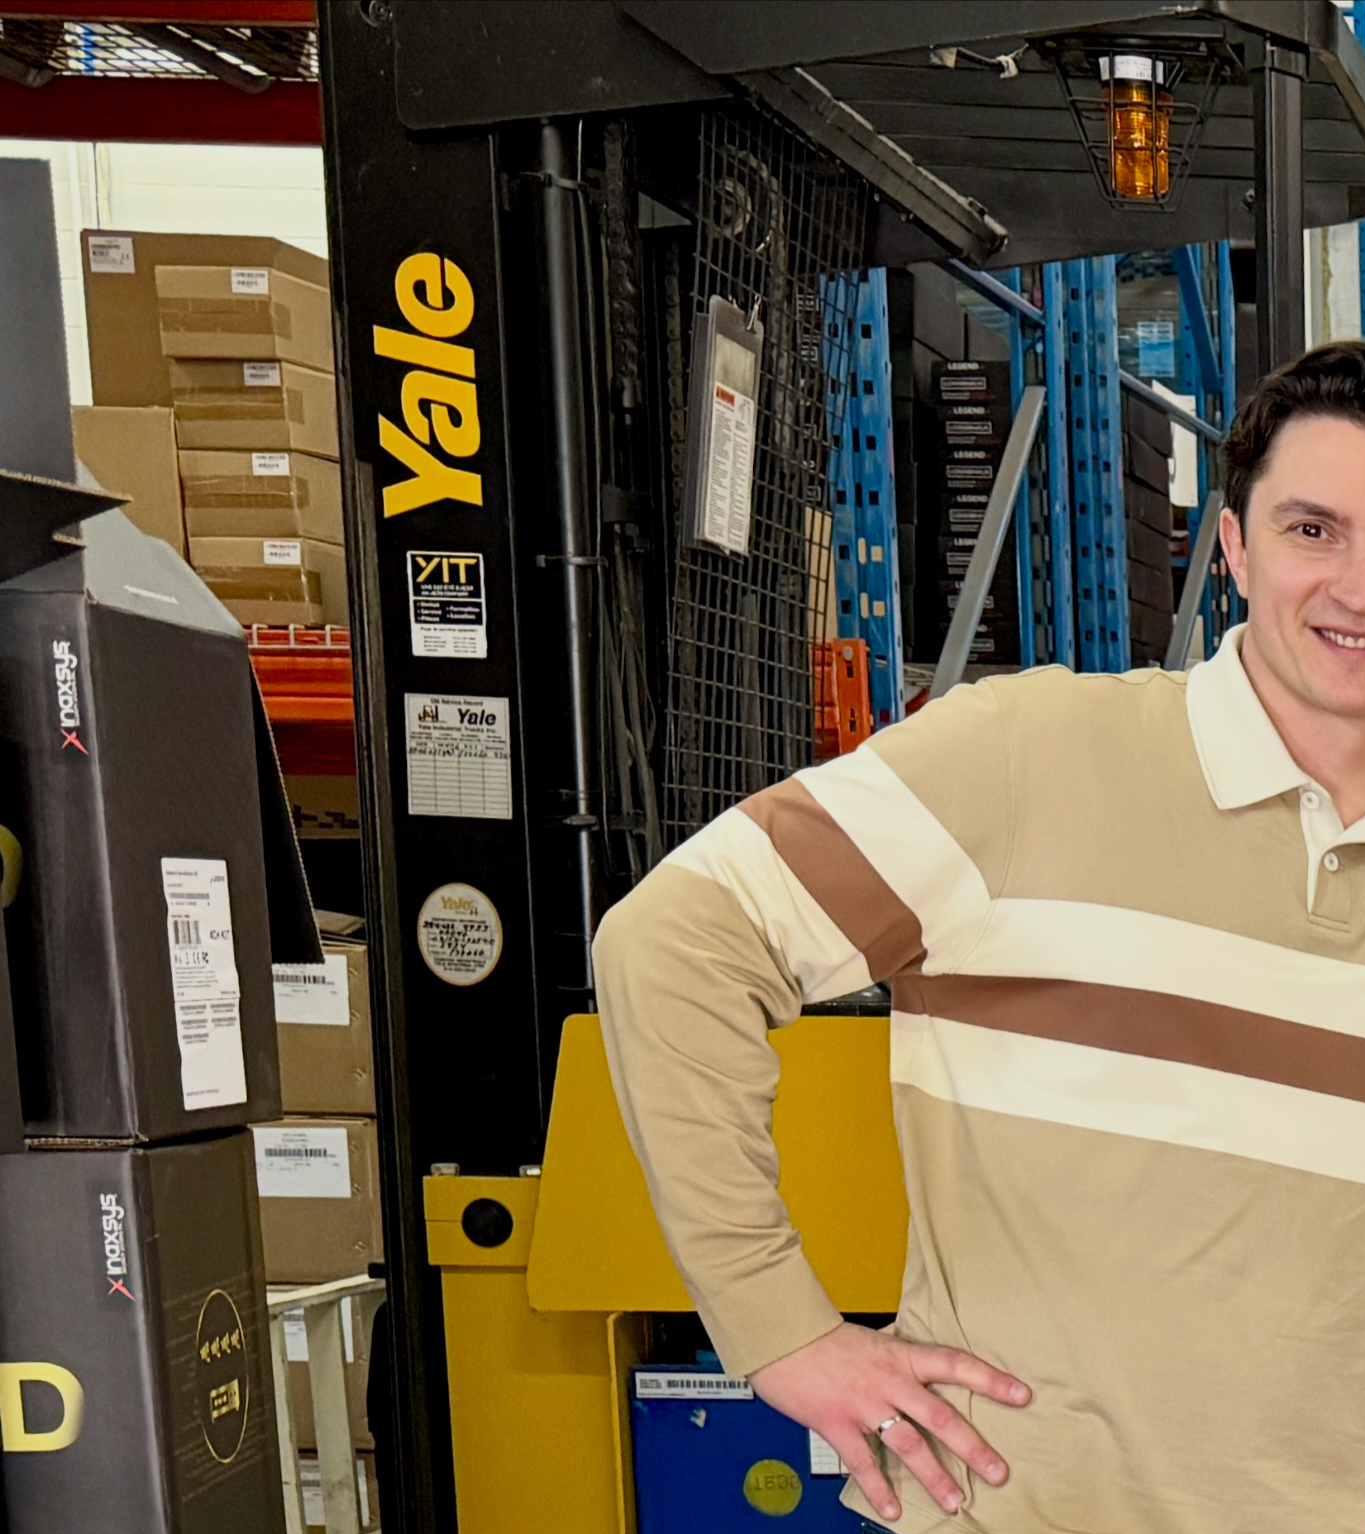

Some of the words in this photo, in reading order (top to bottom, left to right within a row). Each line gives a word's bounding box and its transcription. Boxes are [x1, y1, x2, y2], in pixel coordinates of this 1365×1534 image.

[373, 252, 484, 519] Yale
[415, 556, 477, 584] YIT
[53, 640, 78, 728] inaxsys
[458, 708, 497, 726] Yale
[100, 1193, 125, 1276] inaxsys
